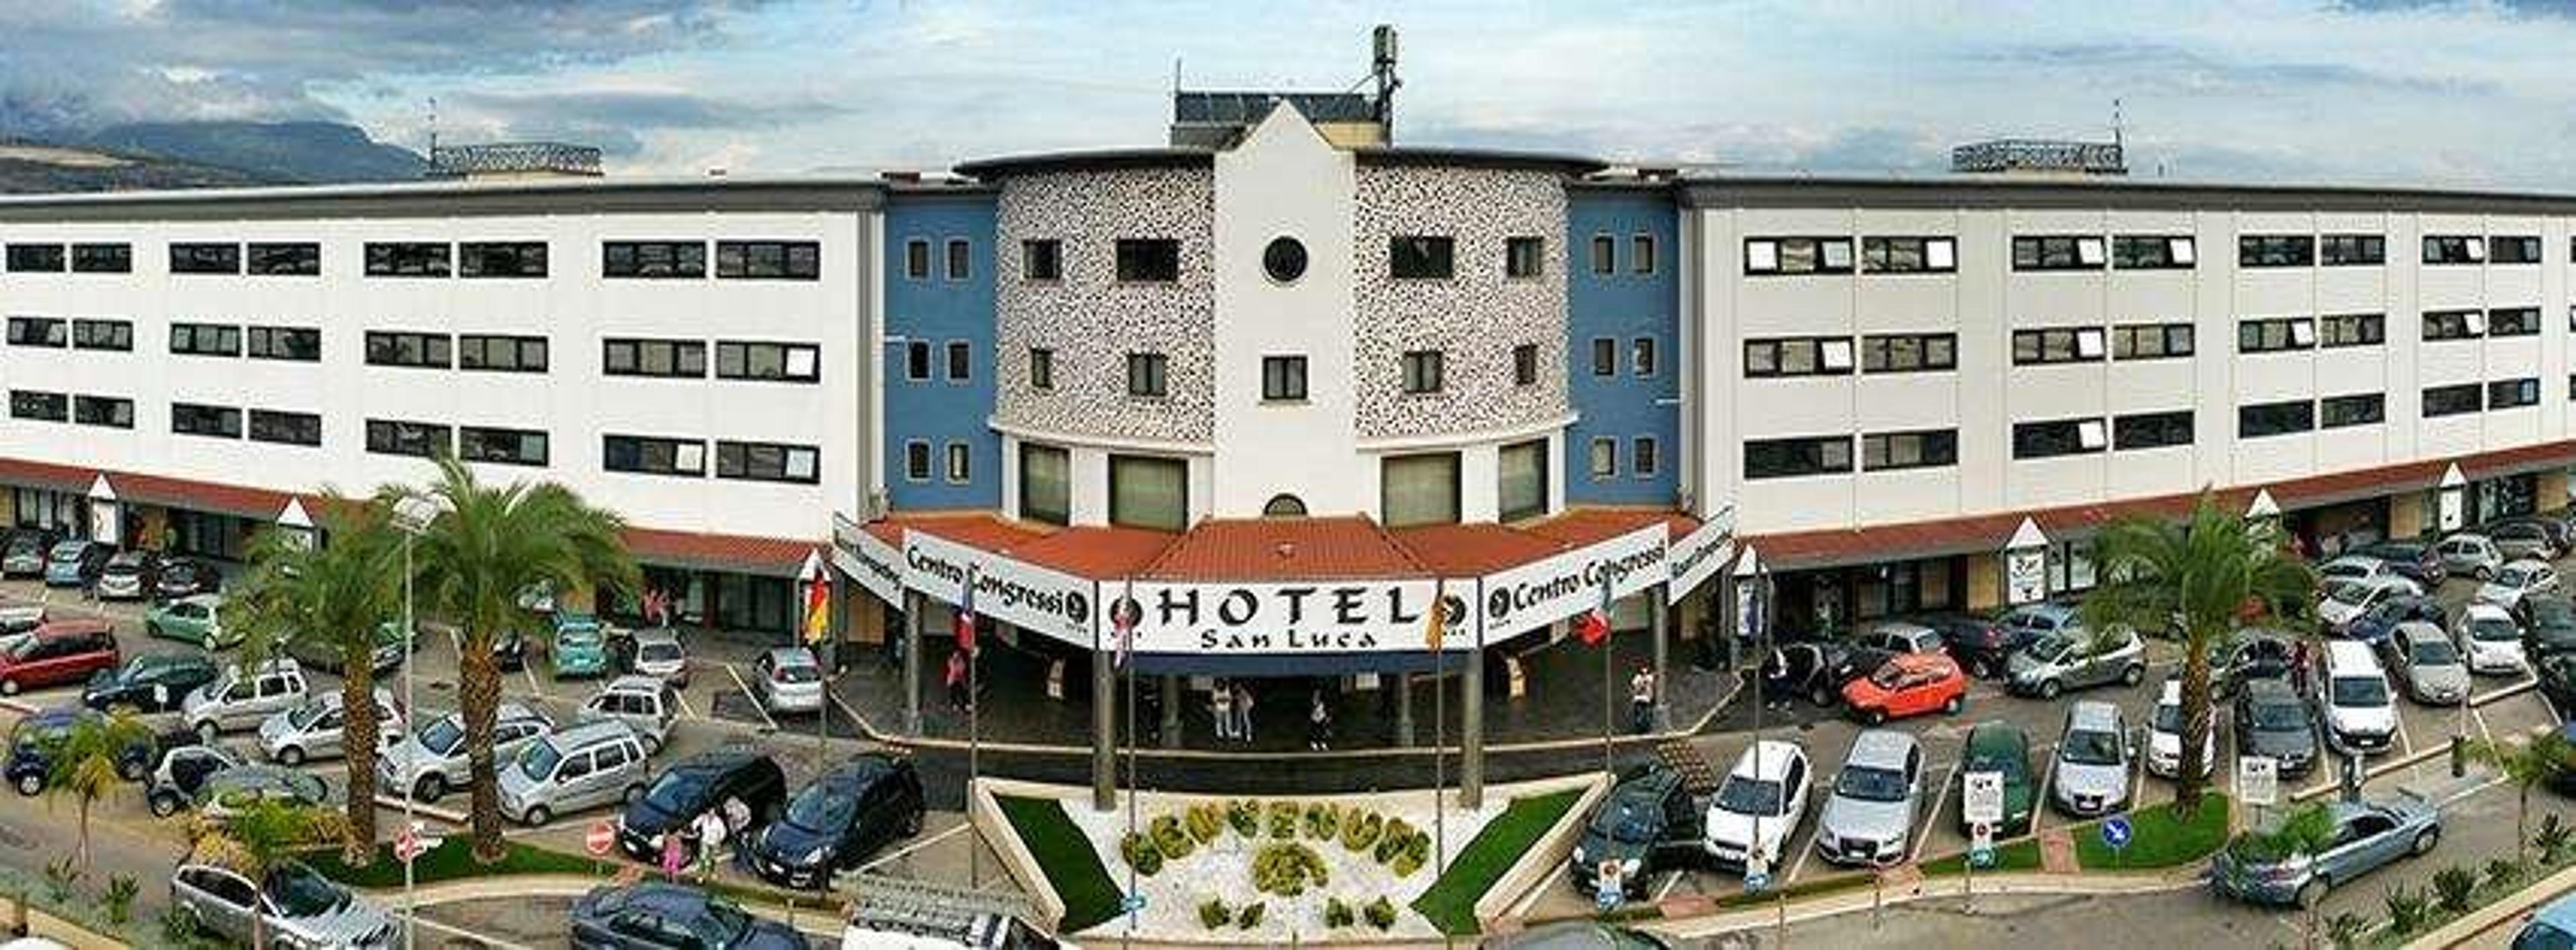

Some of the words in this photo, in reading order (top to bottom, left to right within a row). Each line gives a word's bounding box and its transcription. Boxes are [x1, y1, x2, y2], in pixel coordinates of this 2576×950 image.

[908, 545, 963, 584] Centro
[967, 561, 1063, 615] Congressi
[1513, 574, 1580, 611] Centro
[1157, 586, 1418, 627] HOTEL
[1201, 628, 1271, 649] San
[1287, 628, 1377, 649] Luca
